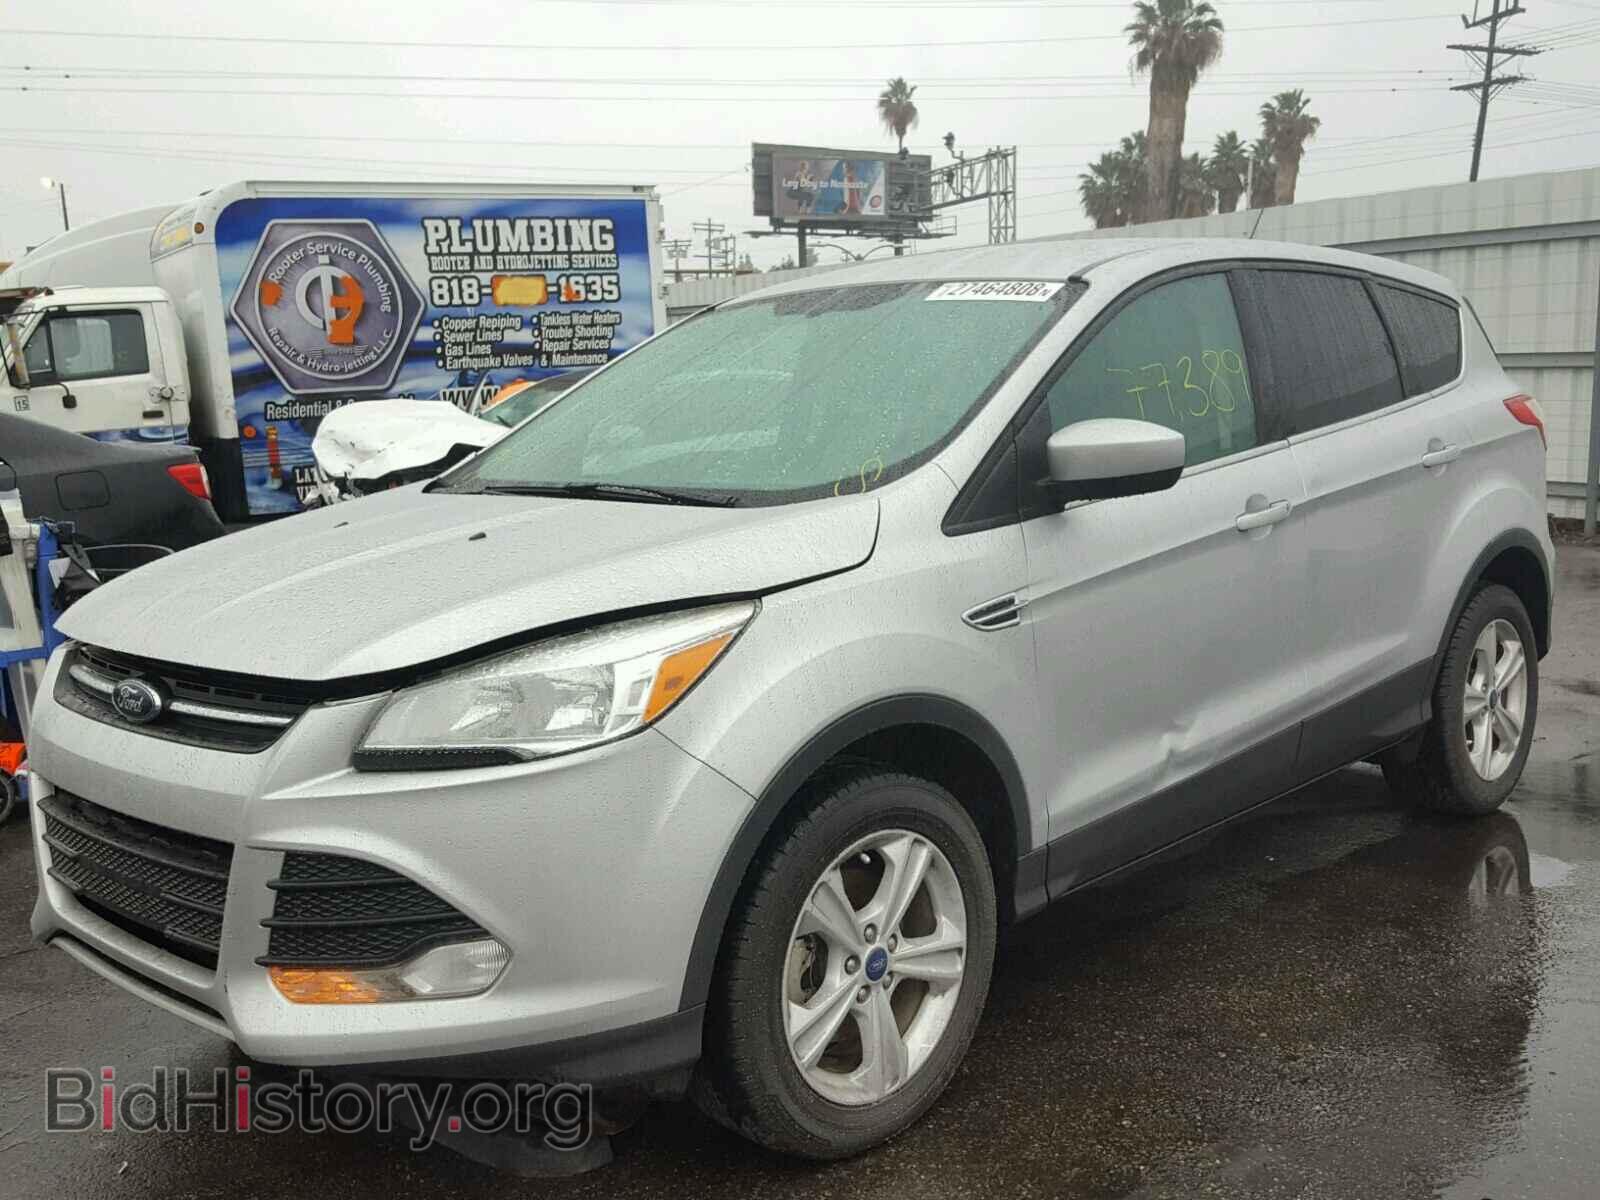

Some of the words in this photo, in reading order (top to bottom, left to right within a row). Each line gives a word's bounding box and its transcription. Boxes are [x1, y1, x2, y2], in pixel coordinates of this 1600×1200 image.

[423, 218, 615, 253] PLUMBING
[431, 256, 471, 271] ROOTER
[474, 256, 494, 270] AND
[496, 254, 569, 270] HYDROJETTING
[571, 253, 617, 269] SERVICES
[268, 248, 305, 284] Rooter
[306, 242, 356, 260] Service
[356, 254, 392, 313] Plumbing
[442, 317, 477, 330] Copper
[540, 314, 571, 325] Tankless
[572, 313, 592, 324] Water
[594, 312, 621, 324] Heaters
[443, 330, 474, 343] Sewer
[476, 329, 502, 342] Lines
[541, 327, 573, 338] Trouble
[575, 326, 613, 338] Shooting
[268, 327, 298, 362] Repair
[445, 344, 464, 355] Gas
[466, 342, 492, 355] Lines
[543, 340, 570, 351] Repair
[572, 339, 609, 350] Services
[446, 356, 501, 370] Earthquake
[503, 353, 533, 366] Valves
[552, 353, 608, 366] Maintenance
[267, 401, 331, 420] Residential
